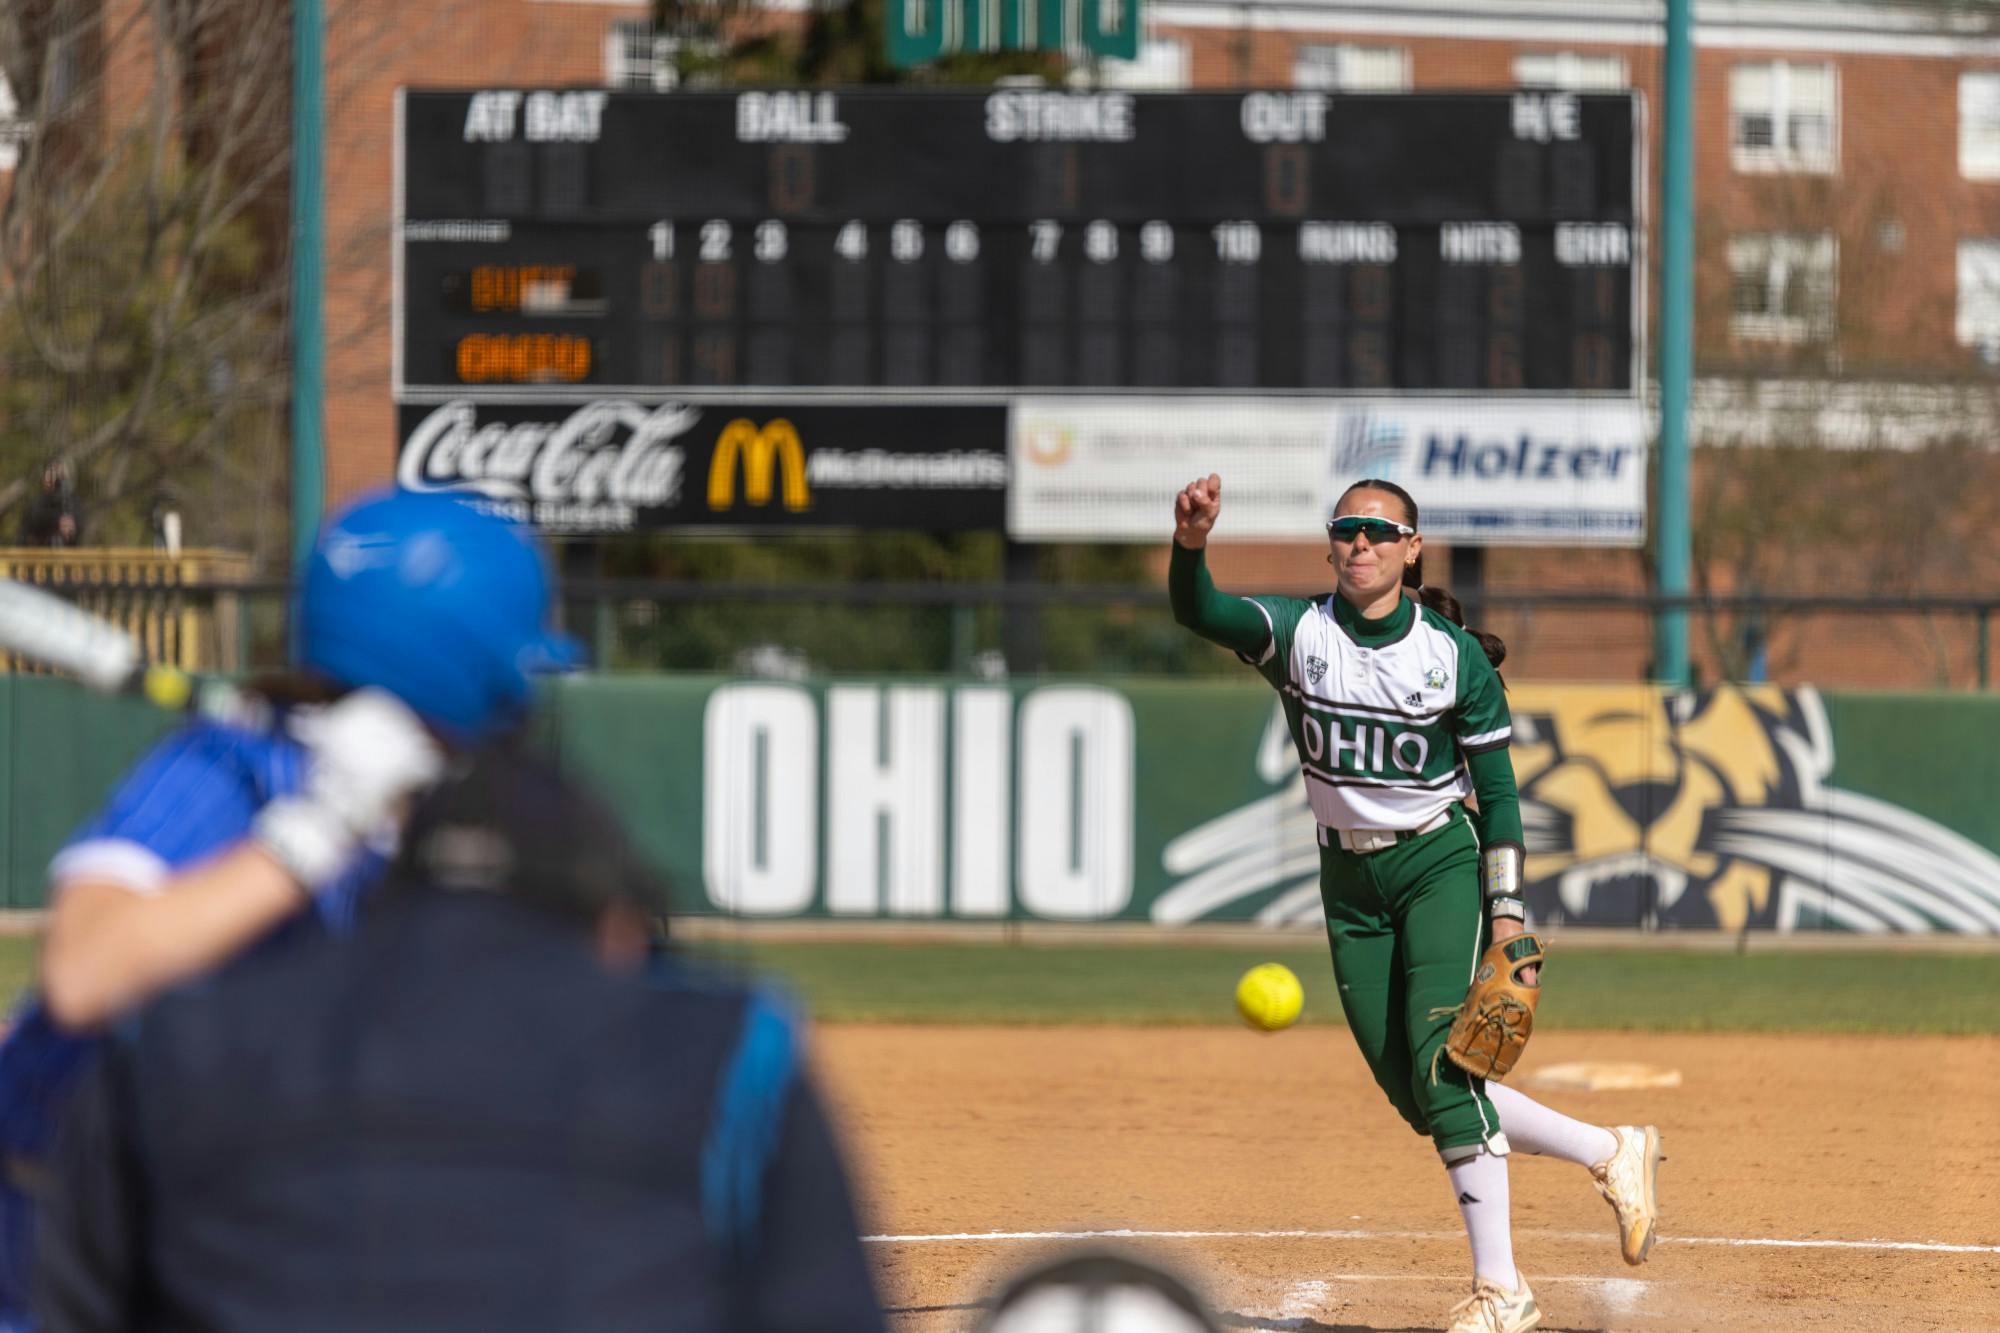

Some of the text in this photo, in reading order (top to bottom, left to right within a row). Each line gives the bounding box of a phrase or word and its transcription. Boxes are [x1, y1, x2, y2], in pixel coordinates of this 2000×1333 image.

[464, 91, 606, 142] AT BAT
[736, 91, 848, 143] BALL
[985, 93, 1135, 143] STRIKE
[1241, 93, 1331, 143] OUT
[649, 220, 675, 262] 1
[701, 220, 733, 262] 2
[754, 220, 787, 262] 3
[835, 220, 867, 262] 4
[892, 220, 924, 262] 5
[945, 220, 979, 262] 6
[1029, 220, 1062, 262] 7
[1085, 220, 1117, 262] 8
[1141, 220, 1172, 262] 9
[1214, 220, 1261, 262] 10
[1300, 221, 1397, 263] RUNS
[1440, 221, 1521, 263] HITS
[1422, 433, 1632, 479] Holzer
[1302, 712, 1428, 774] OHIO
[702, 683, 1136, 918] OHIO
